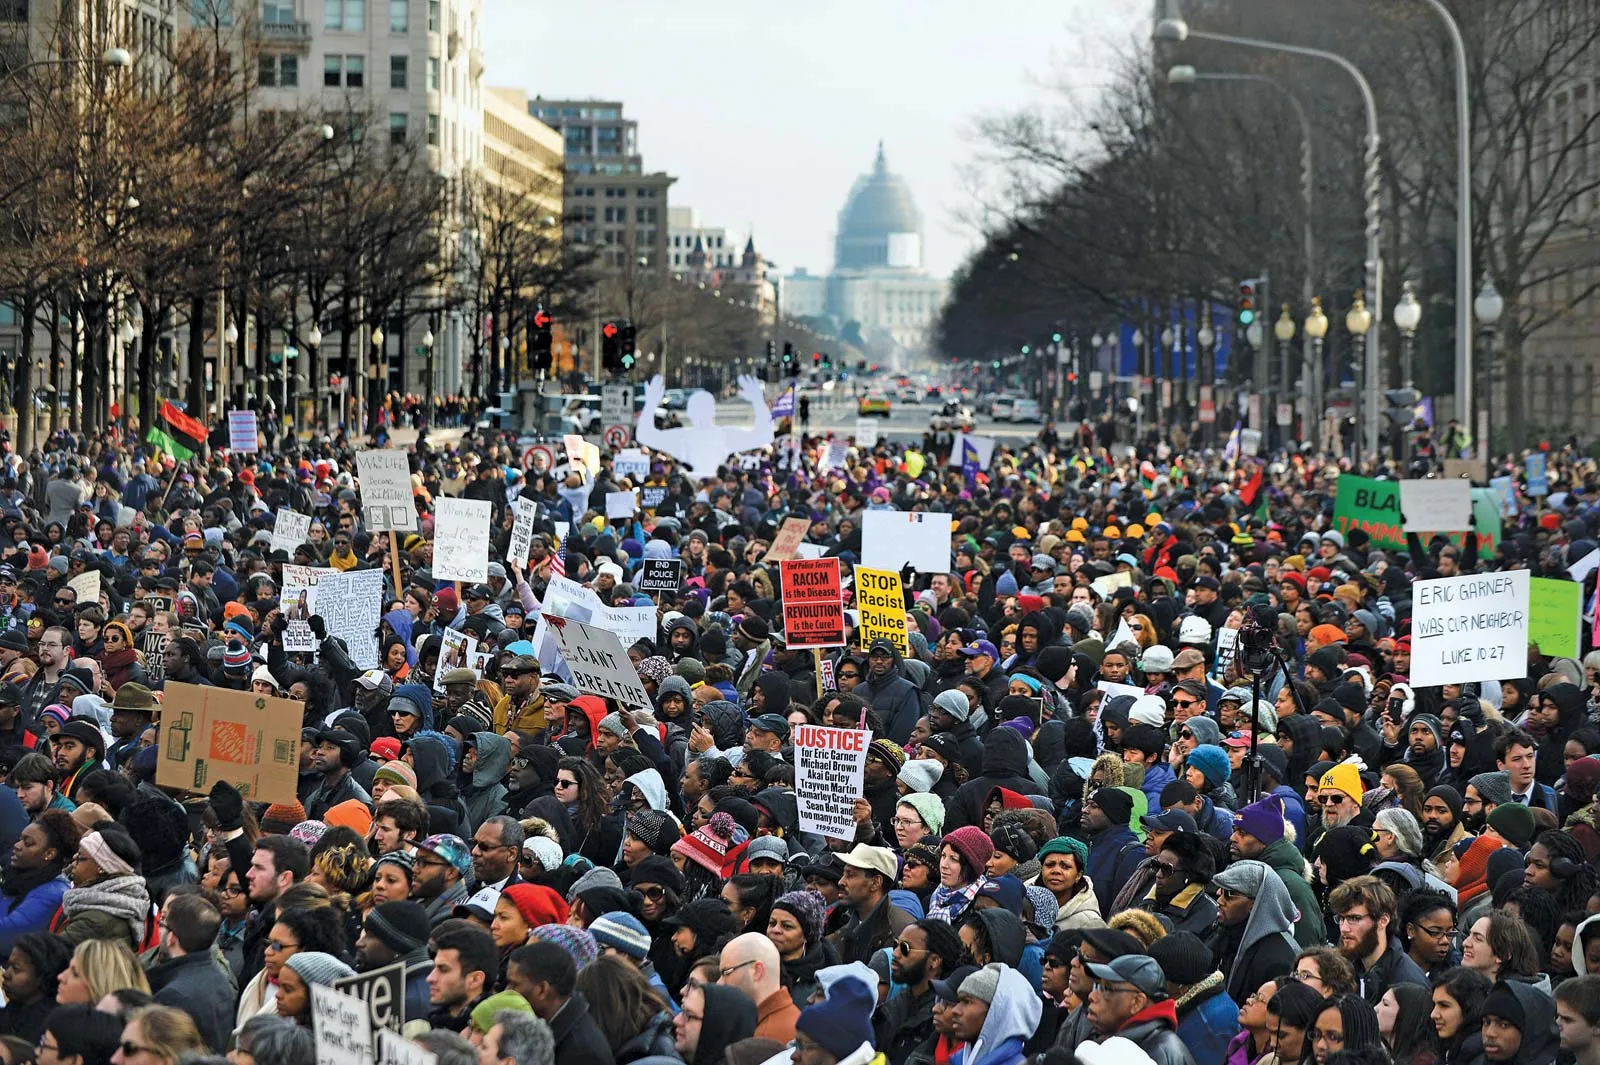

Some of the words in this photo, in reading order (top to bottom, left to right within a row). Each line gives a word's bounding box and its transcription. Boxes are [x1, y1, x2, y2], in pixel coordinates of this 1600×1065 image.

[1354, 488, 1401, 513] BLA
[457, 567, 484, 579] COPS
[655, 561, 670, 569] END
[798, 562, 815, 570] Police
[649, 570, 674, 579] POLICE
[792, 571, 829, 587] RACISM
[861, 572, 898, 591] STOP
[643, 579, 677, 588] BRUTALITY
[1420, 585, 1455, 606] ERIC
[1459, 577, 1516, 601] GARNER
[785, 589, 793, 599] is
[793, 588, 806, 598] the
[807, 587, 838, 599] Disease,
[859, 589, 904, 610] Racist
[786, 604, 841, 619] REVOLUTION
[861, 610, 905, 630] Police
[793, 621, 800, 631] is
[801, 620, 814, 630] the
[815, 619, 835, 630] Cure!
[1418, 617, 1445, 635] WAS
[1470, 610, 1524, 632] NEIGHBOR
[579, 623, 590, 641] I
[862, 624, 906, 644] Terror
[576, 645, 618, 671] CAN'T
[1441, 647, 1473, 665] LUKE
[573, 670, 648, 706] BREATHE
[796, 727, 864, 752] JUSTICE
[801, 747, 813, 758] for
[814, 748, 829, 760] Eric
[830, 750, 858, 762] Garner
[800, 757, 831, 771] Michael
[832, 760, 858, 773] Brown
[807, 769, 824, 781] Akai
[824, 770, 850, 786] Gurley
[800, 778, 830, 793] Trayvon
[830, 782, 858, 795] Martin
[797, 788, 832, 804] Ramarley
[832, 792, 856, 805] Graha
[805, 800, 825, 812] Sean
[825, 802, 839, 814] Bell
[840, 805, 854, 817] and
[800, 810, 813, 820] too
[813, 812, 833, 825] many
[815, 823, 846, 835] 1199SEIU
